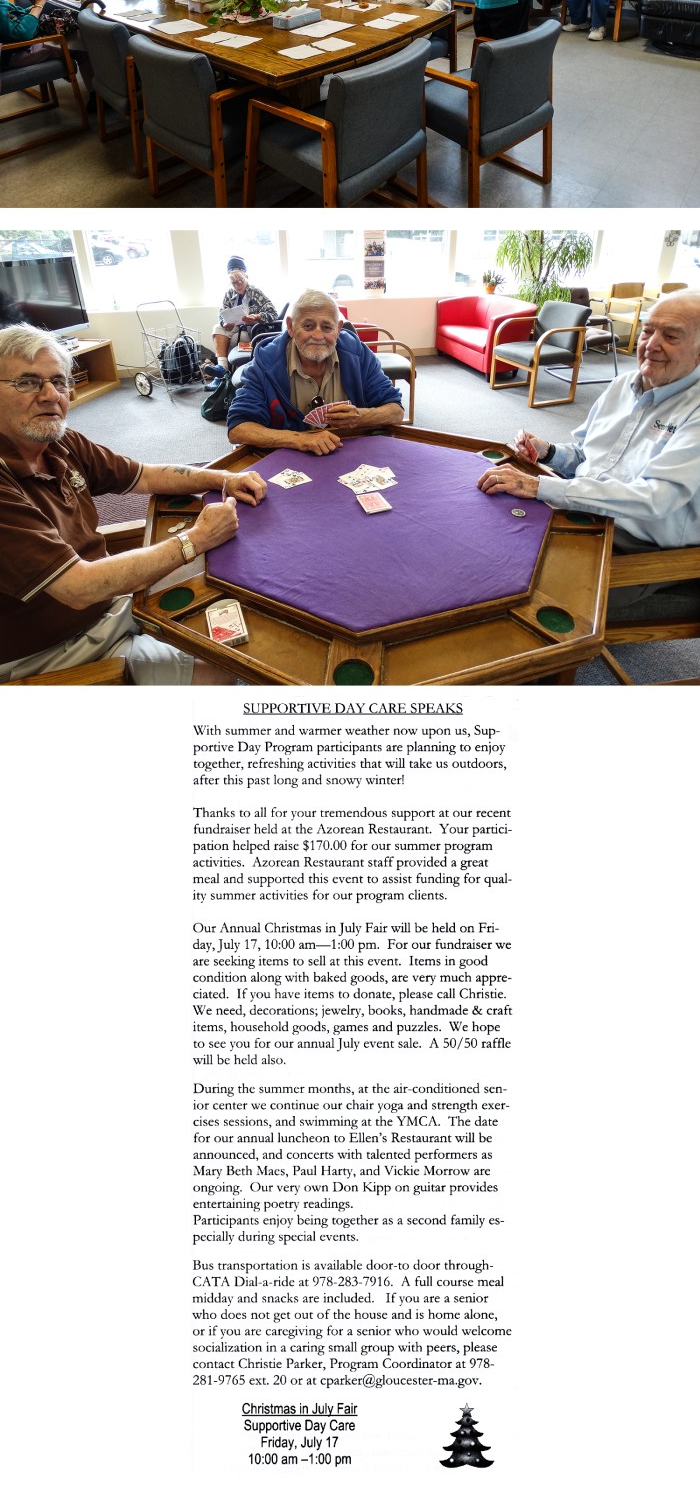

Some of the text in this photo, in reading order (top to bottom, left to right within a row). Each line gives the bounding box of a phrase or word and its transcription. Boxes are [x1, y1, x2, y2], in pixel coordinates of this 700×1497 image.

[243, 702, 463, 713] SUPPORTIVE DAY CARE SPEAKS
[193, 725, 221, 736] With
[225, 728, 272, 736] summer
[275, 724, 295, 736] and
[298, 728, 342, 736] warmer
[345, 725, 390, 736] weather
[421, 728, 451, 739] upon
[455, 728, 471, 738] us,
[474, 724, 500, 739] Sup-
[193, 839, 493, 854] pation helped raise $170.00 for our summer program
[193, 1004, 512, 1019] We need, decorations; jewelry, books, handmade & craft
[193, 1116, 220, 1127] cises
[223, 1116, 272, 1128] sessions,
[275, 1115, 296, 1126] and
[299, 1116, 358, 1130] swimming
[375, 1116, 393, 1127] the
[396, 1115, 441, 1126] YMCA.
[448, 1116, 471, 1127] The
[474, 1115, 498, 1127] date
[192, 1275, 504, 1287] CATA Dial-a-ride at 978-283-7916. A full course meal
[193, 1358, 494, 1372] contact Christie Parker, Program Coordinator at 978-
[193, 1374, 246, 1385] 281-9765
[249, 1377, 269, 1385] ext.
[273, 1374, 287, 1385] 20
[306, 1377, 316, 1385] at
[320, 1373, 482, 1389] cparker@gloucester-ma.gov.
[242, 1402, 358, 1416] Christmas in July Fair
[244, 1419, 356, 1434] Supportive Day Care
[261, 1436, 339, 1451] Friday, July 17
[248, 1453, 278, 1465] 10:00
[281, 1455, 298, 1465] am
[335, 1455, 352, 1467] pm
